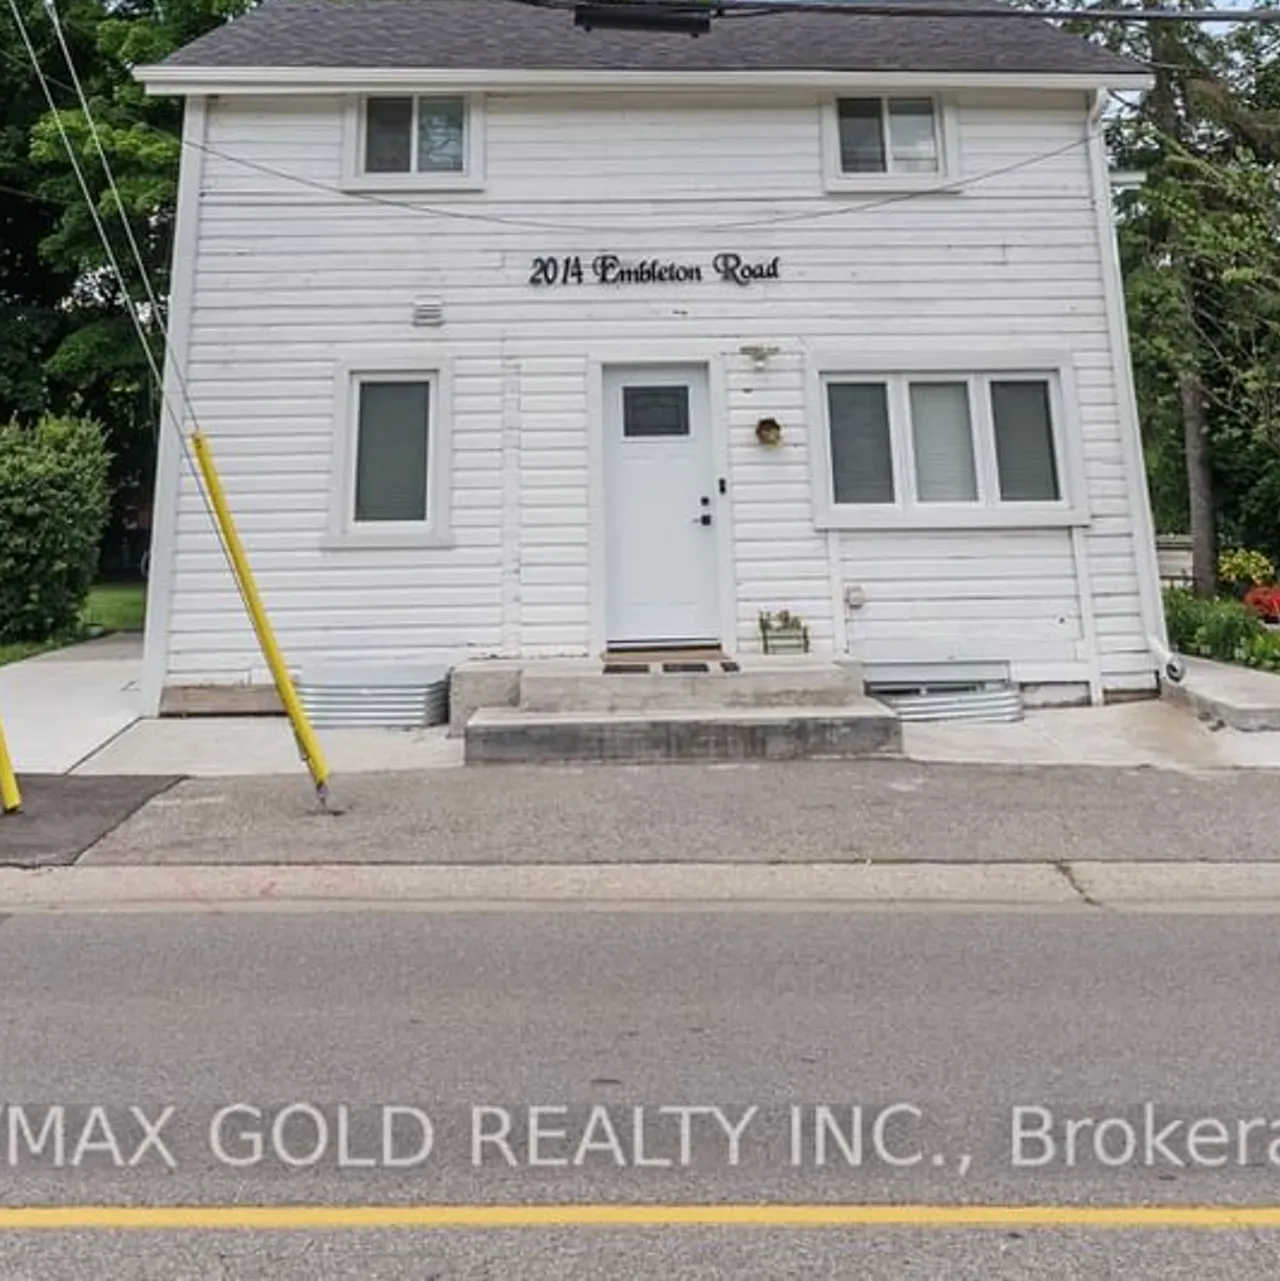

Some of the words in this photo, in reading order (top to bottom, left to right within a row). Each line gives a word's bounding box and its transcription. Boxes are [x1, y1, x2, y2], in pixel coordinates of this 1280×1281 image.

[529, 256, 583, 285] 2014
[592, 254, 702, 285] Embleton
[712, 252, 780, 286] Road
